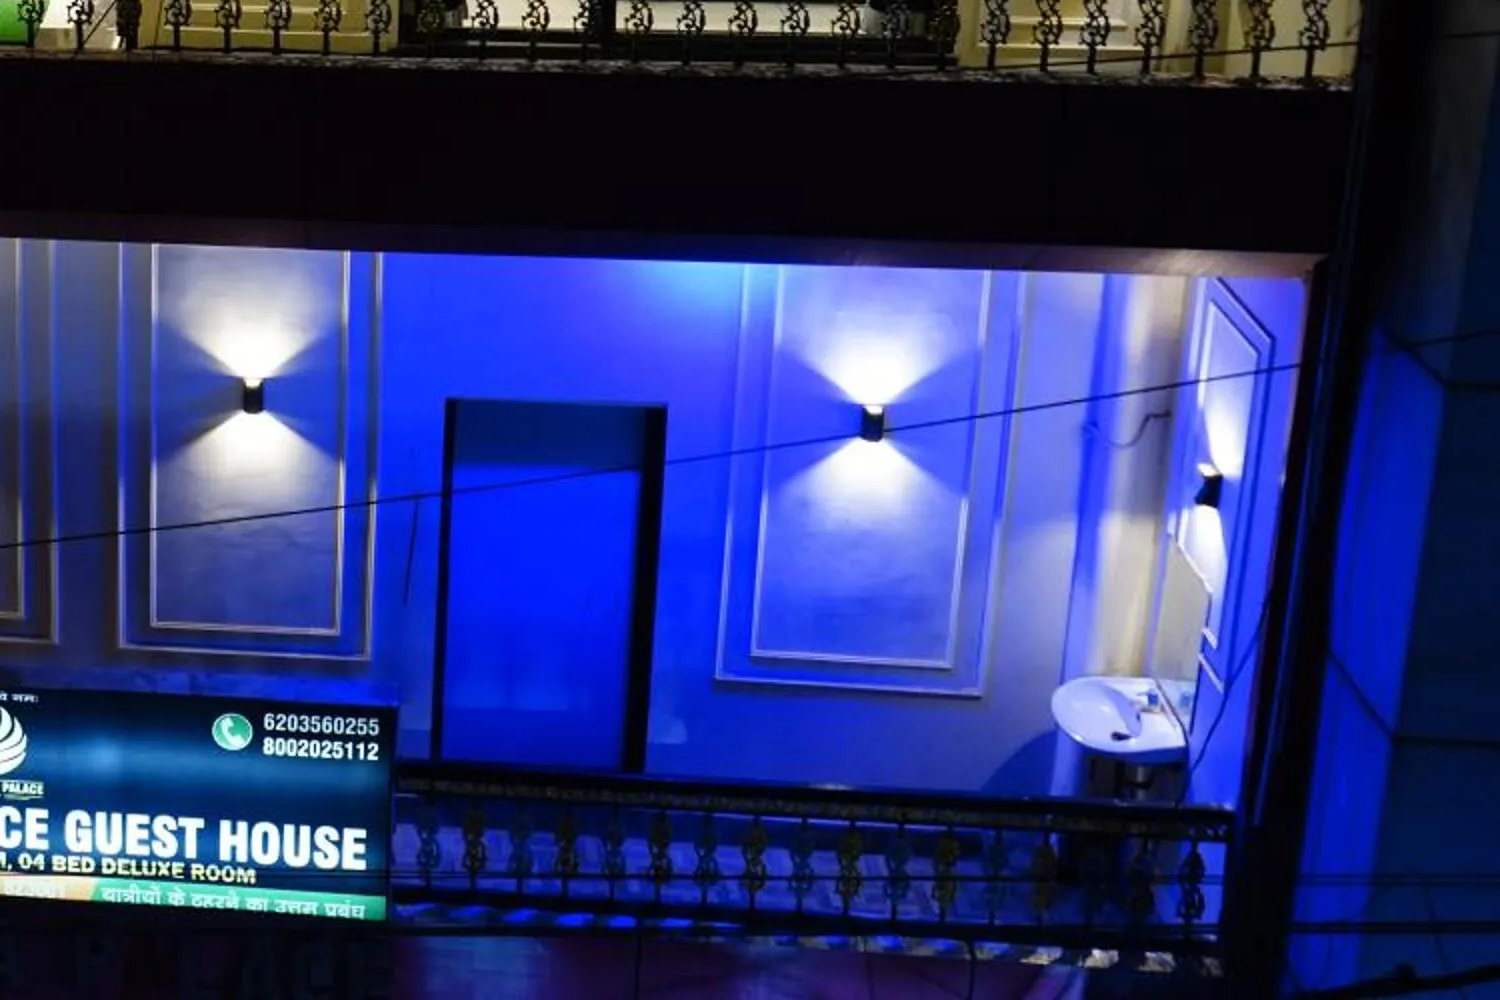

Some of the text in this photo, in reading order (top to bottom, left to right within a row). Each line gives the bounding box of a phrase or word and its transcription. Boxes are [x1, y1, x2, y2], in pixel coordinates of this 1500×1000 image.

[263, 713, 380, 736] 6203560255
[262, 737, 380, 761] 8002025112
[1, 781, 44, 795] PALACE
[64, 809, 205, 859] GUEST
[219, 819, 367, 871] HOUSE
[18, 852, 45, 870] 04
[52, 855, 96, 873] BED
[102, 857, 184, 879] DELUXE
[191, 863, 257, 885] ROOM
